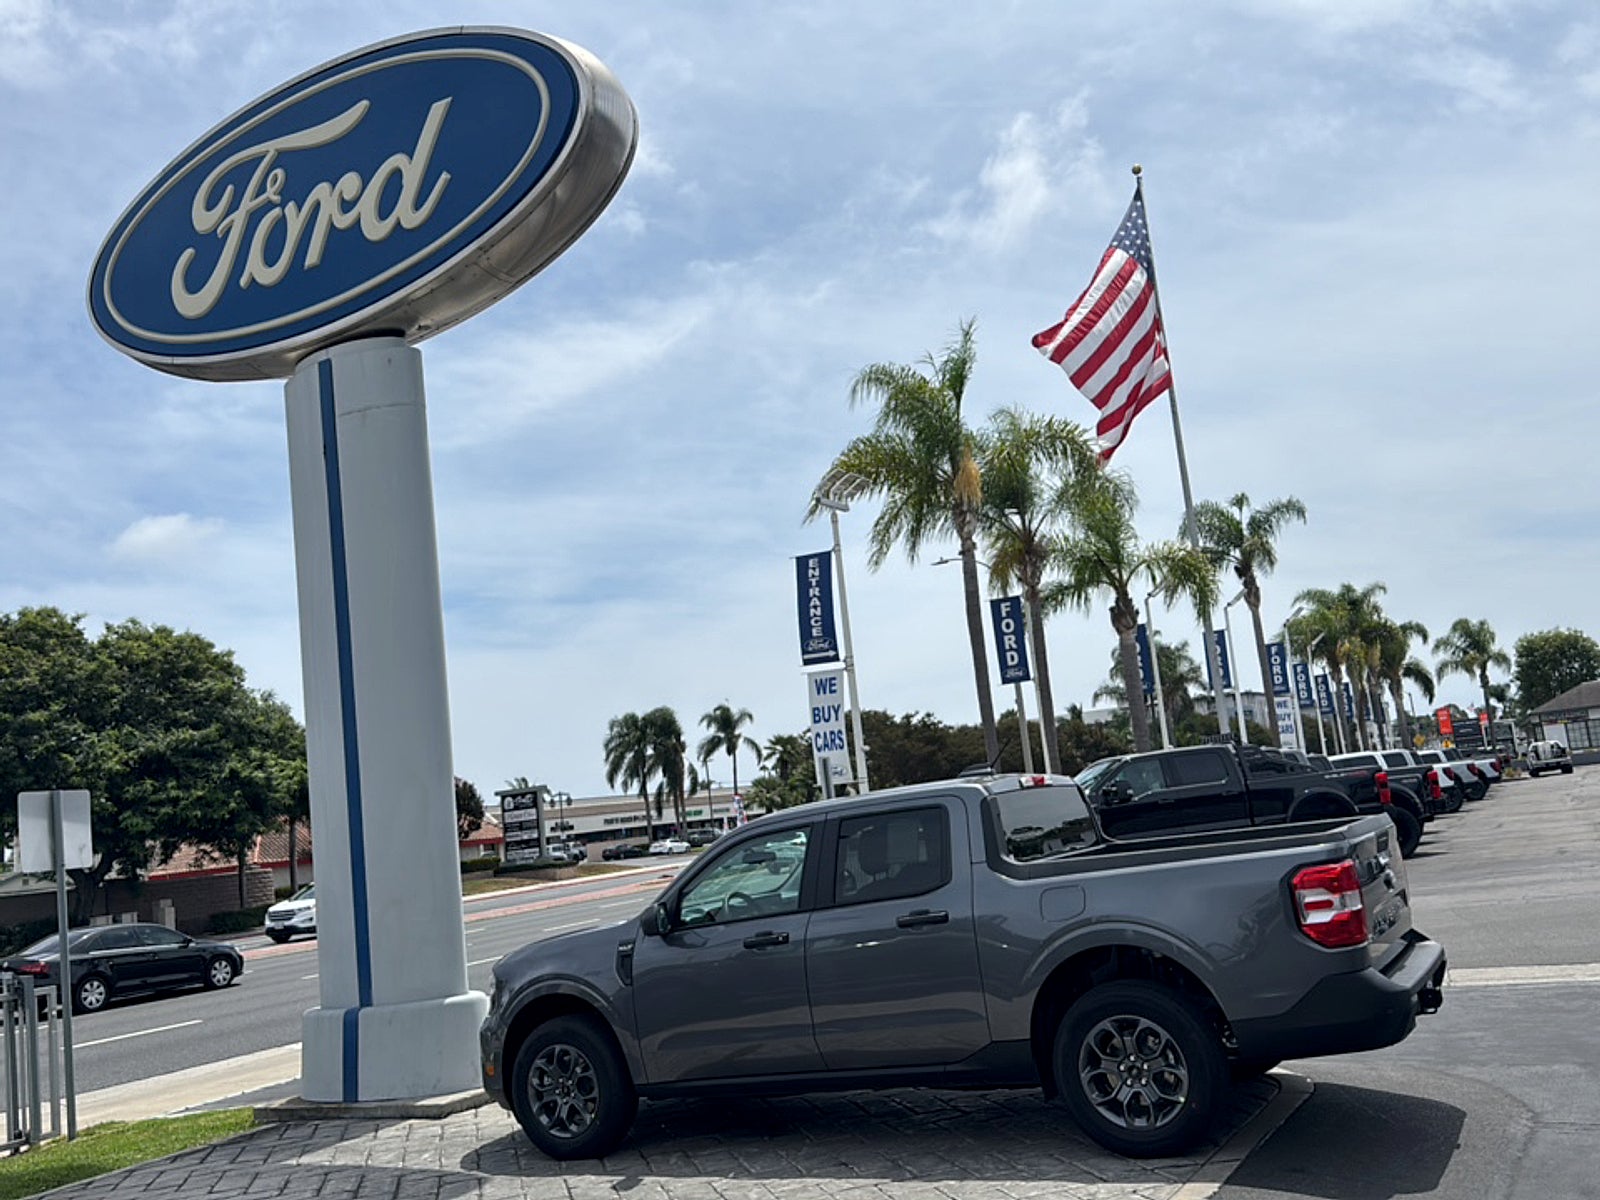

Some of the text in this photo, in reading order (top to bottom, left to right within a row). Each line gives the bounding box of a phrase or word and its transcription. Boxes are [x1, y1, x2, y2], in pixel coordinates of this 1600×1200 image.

[171, 97, 452, 319] Ford
[808, 558, 823, 637] ENTRANCE
[807, 637, 831, 651] Ford
[1000, 601, 1019, 667] FORD
[1270, 645, 1283, 685] FORD
[815, 677, 837, 695] WE
[1296, 665, 1308, 698] FORD
[1316, 676, 1328, 706] FORD
[813, 704, 841, 724] BUY
[815, 729, 845, 752] CARS
